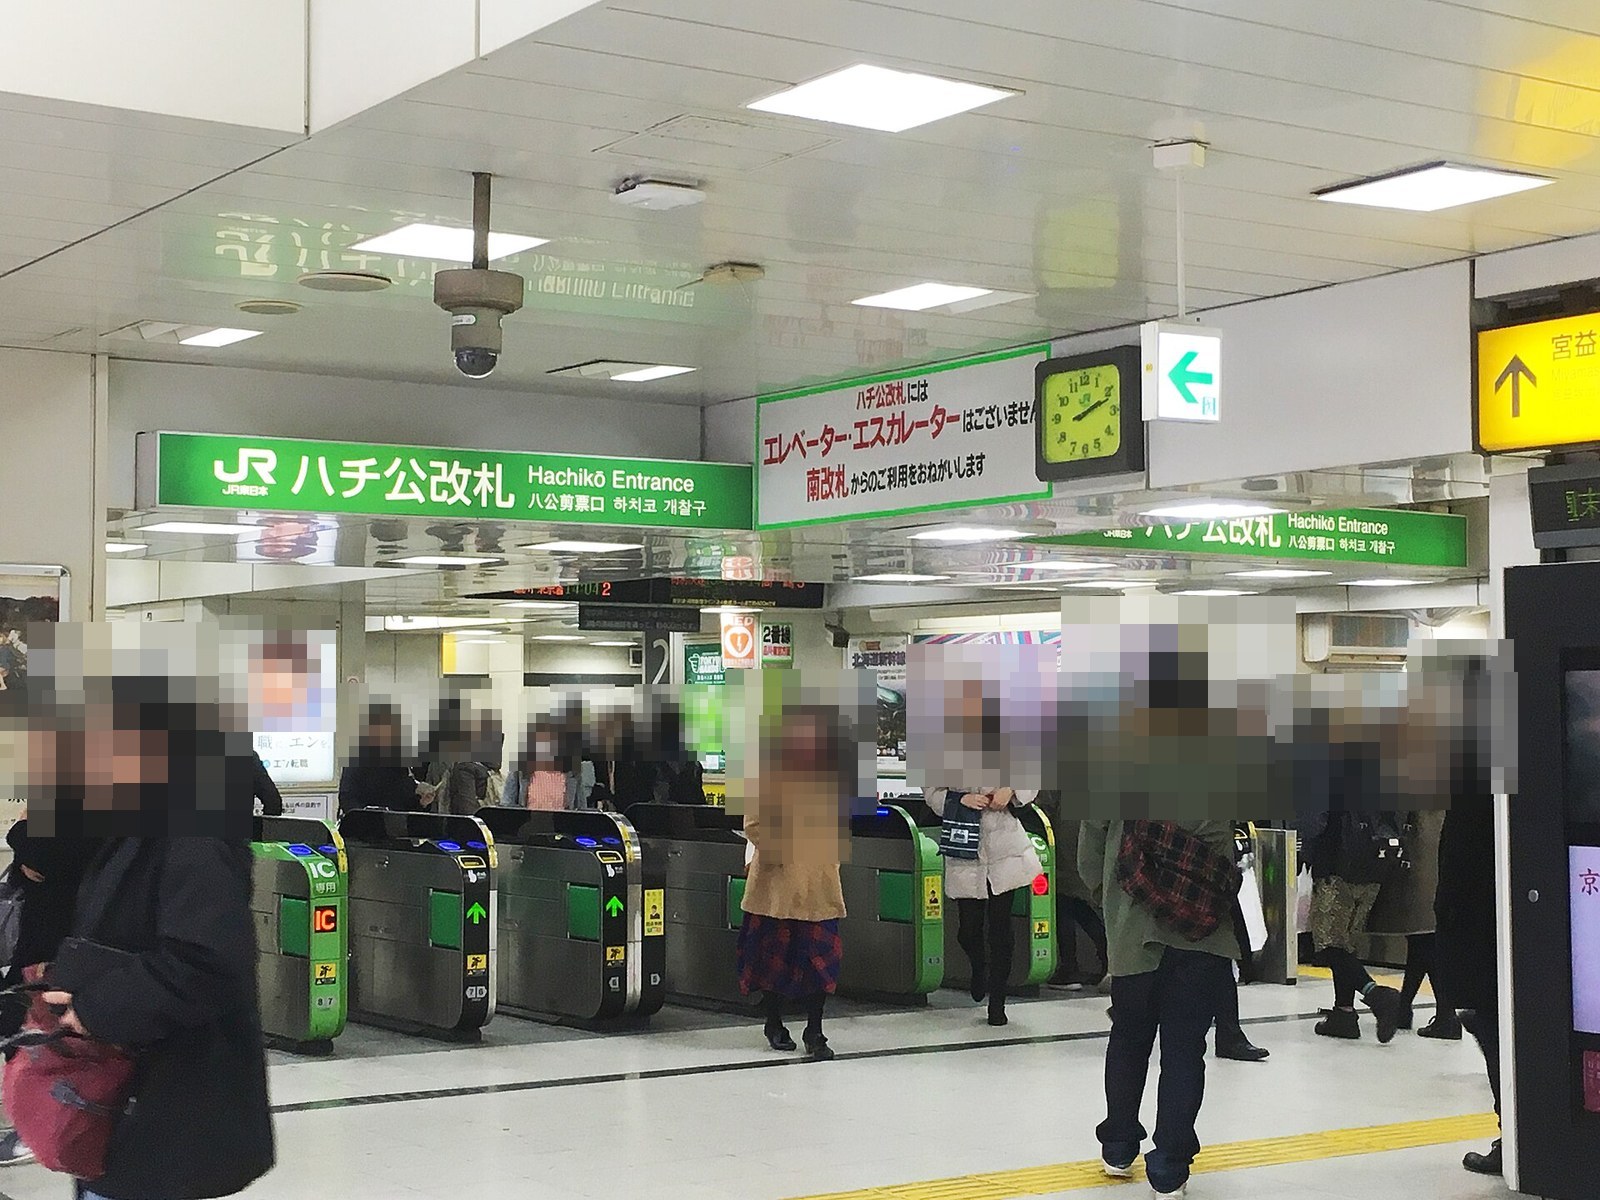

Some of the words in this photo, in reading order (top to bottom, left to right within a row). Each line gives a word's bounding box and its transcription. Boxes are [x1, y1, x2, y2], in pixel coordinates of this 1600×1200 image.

[1551, 329, 1597, 361] 宮益
[1080, 375, 1090, 386] 12
[1094, 377, 1099, 388] 1
[1069, 382, 1078, 393] 11
[1105, 386, 1112, 397] 2
[856, 379, 928, 410] ハチ公改札には
[1059, 396, 1069, 407] 10
[1109, 405, 1117, 416] 3
[1054, 413, 1061, 424] 9
[1105, 425, 1112, 436] 4
[1060, 432, 1066, 442] 8
[1070, 442, 1077, 453] 7
[1082, 444, 1089, 454] 6
[1094, 438, 1101, 449] 5
[213, 447, 277, 484] JR
[290, 455, 516, 510] ハチ公改札
[528, 465, 606, 488] Hachikō
[612, 469, 695, 493] Entrance
[806, 452, 986, 502] 南改札からのご利用をおねがいします
[222, 484, 268, 496] JR東日本
[528, 492, 605, 513] 八公剪票口
[613, 496, 658, 514] 하치코
[663, 498, 707, 517] 개찰구
[1287, 513, 1335, 531] Hachikō
[1338, 516, 1388, 536] Entrance
[1339, 538, 1366, 553] 하치코
[601, 581, 612, 597] 2
[724, 616, 754, 627] ED
[652, 638, 669, 684] 2
[308, 861, 337, 879] IC
[1579, 867, 1600, 896] 京
[315, 882, 337, 894] 専用
[315, 909, 336, 931] IC
